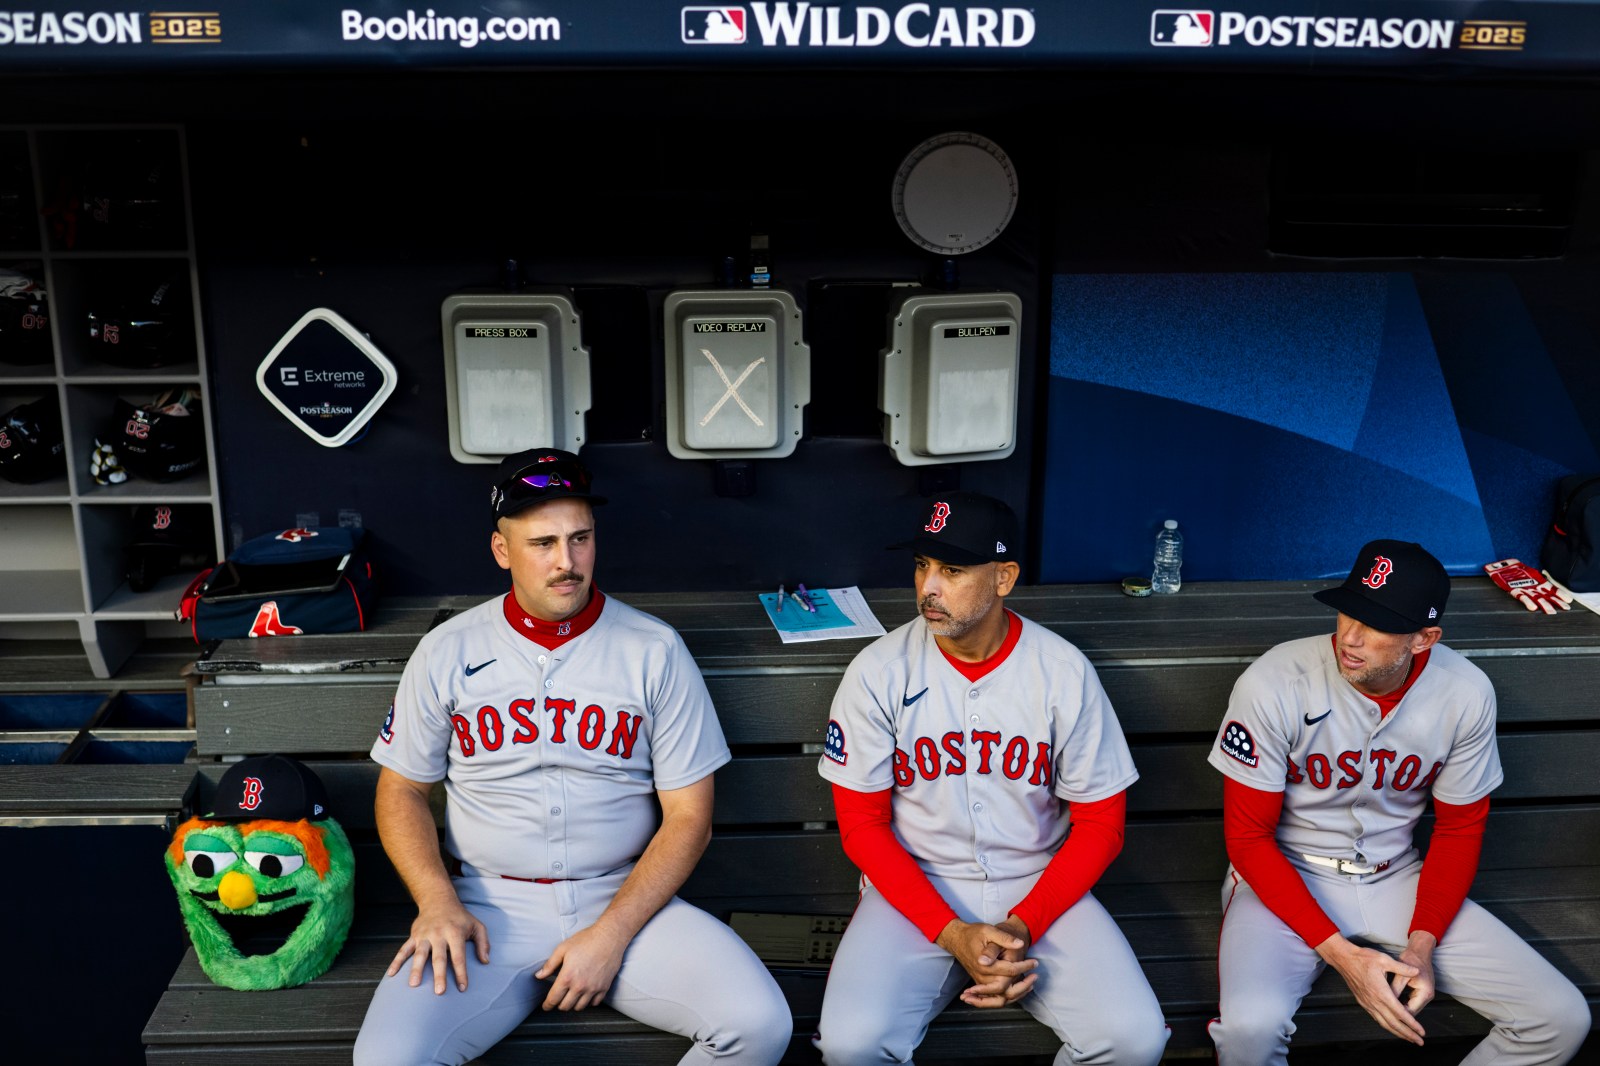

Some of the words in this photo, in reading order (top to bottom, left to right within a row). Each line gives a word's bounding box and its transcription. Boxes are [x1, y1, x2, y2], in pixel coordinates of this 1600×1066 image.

[0, 12, 142, 45] SEASON
[150, 18, 221, 37] 2025
[341, 9, 561, 49] Booking.com
[1218, 12, 1455, 49] POSTSEASON
[1460, 27, 1526, 45] 2025
[103, 323, 120, 345] 12
[474, 328, 505, 337] PRESS
[509, 328, 528, 337] BOX
[696, 323, 723, 332] VIDEO
[727, 323, 764, 332] REPLAY
[958, 327, 997, 337] BULLPEN
[304, 369, 365, 382] Extreme
[334, 381, 366, 389] networks
[300, 406, 353, 415] POSTSEASON
[125, 419, 151, 440] 20
[152, 505, 172, 530] B
[924, 501, 952, 534] B
[1361, 555, 1394, 590] B
[450, 696, 643, 760] BOSTON
[239, 777, 265, 811] B
